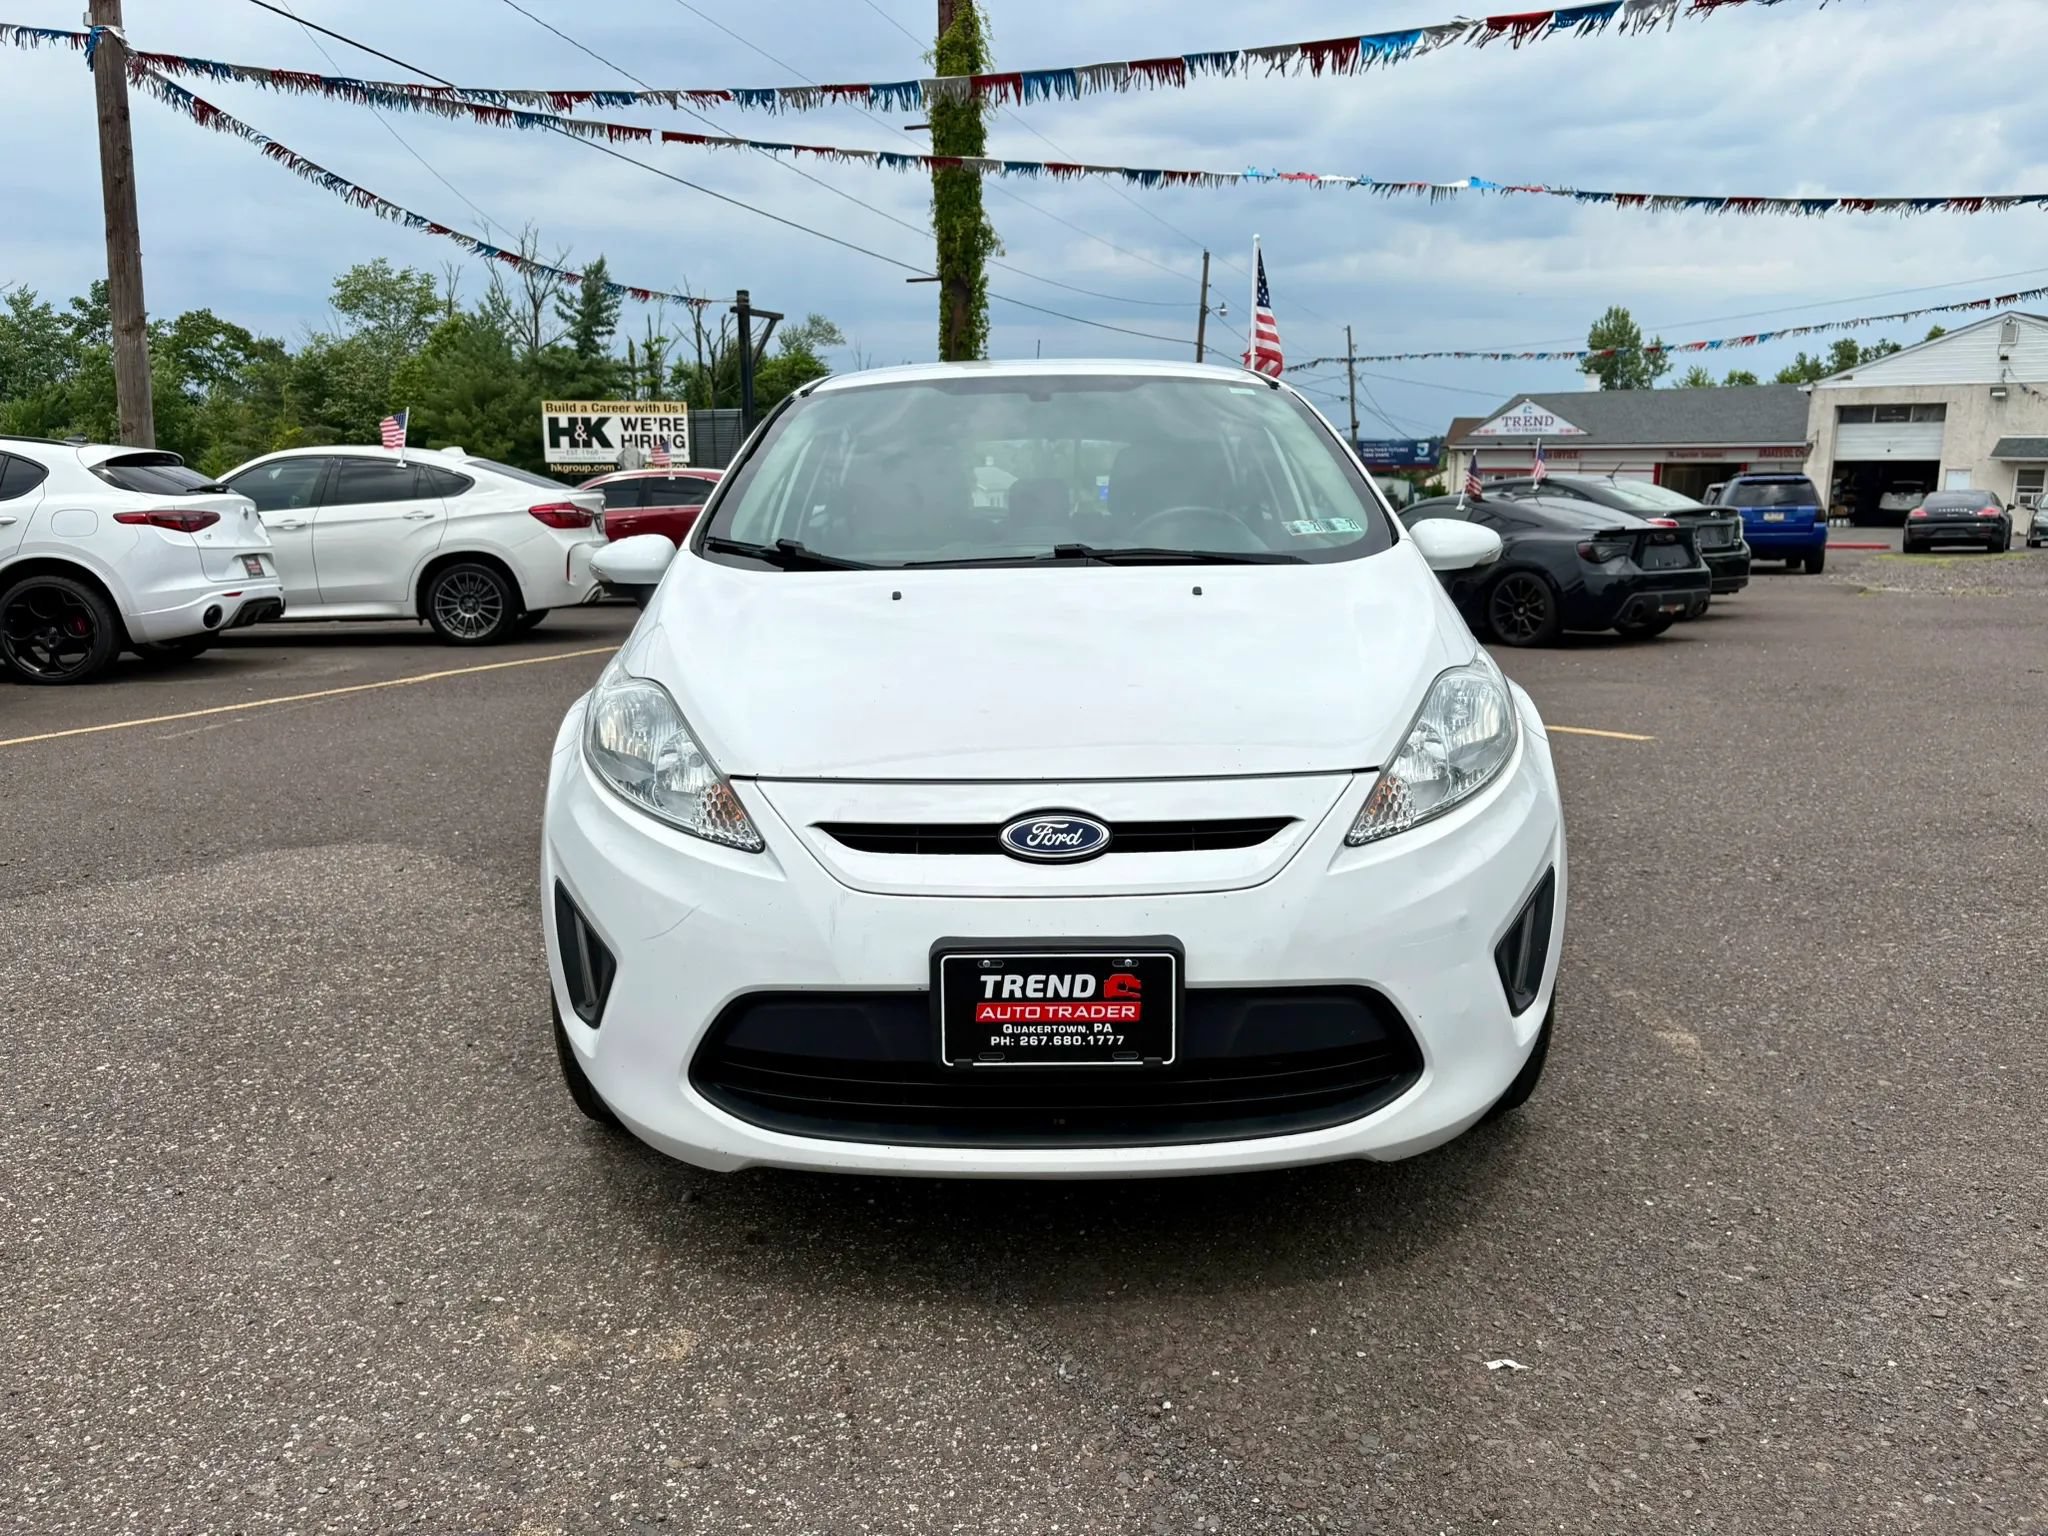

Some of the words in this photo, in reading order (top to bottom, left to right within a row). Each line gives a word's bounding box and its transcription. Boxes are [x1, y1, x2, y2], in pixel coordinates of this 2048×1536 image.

[546, 403, 576, 413] Build
[591, 404, 630, 413] Career
[634, 403, 660, 413] with
[621, 417, 685, 432] WE'RE
[1502, 415, 1554, 427] TREND
[548, 417, 614, 448] H&K
[550, 464, 615, 473] hkgroup.com
[1026, 822, 1083, 846] Ford
[980, 974, 1096, 998] TREND
[979, 1006, 1040, 1019] AUTO
[1044, 1006, 1135, 1018] TRADER
[1094, 1024, 1113, 1033] PA
[991, 1036, 1014, 1046] PH:
[1020, 1036, 1125, 1046] 267.680.1777
